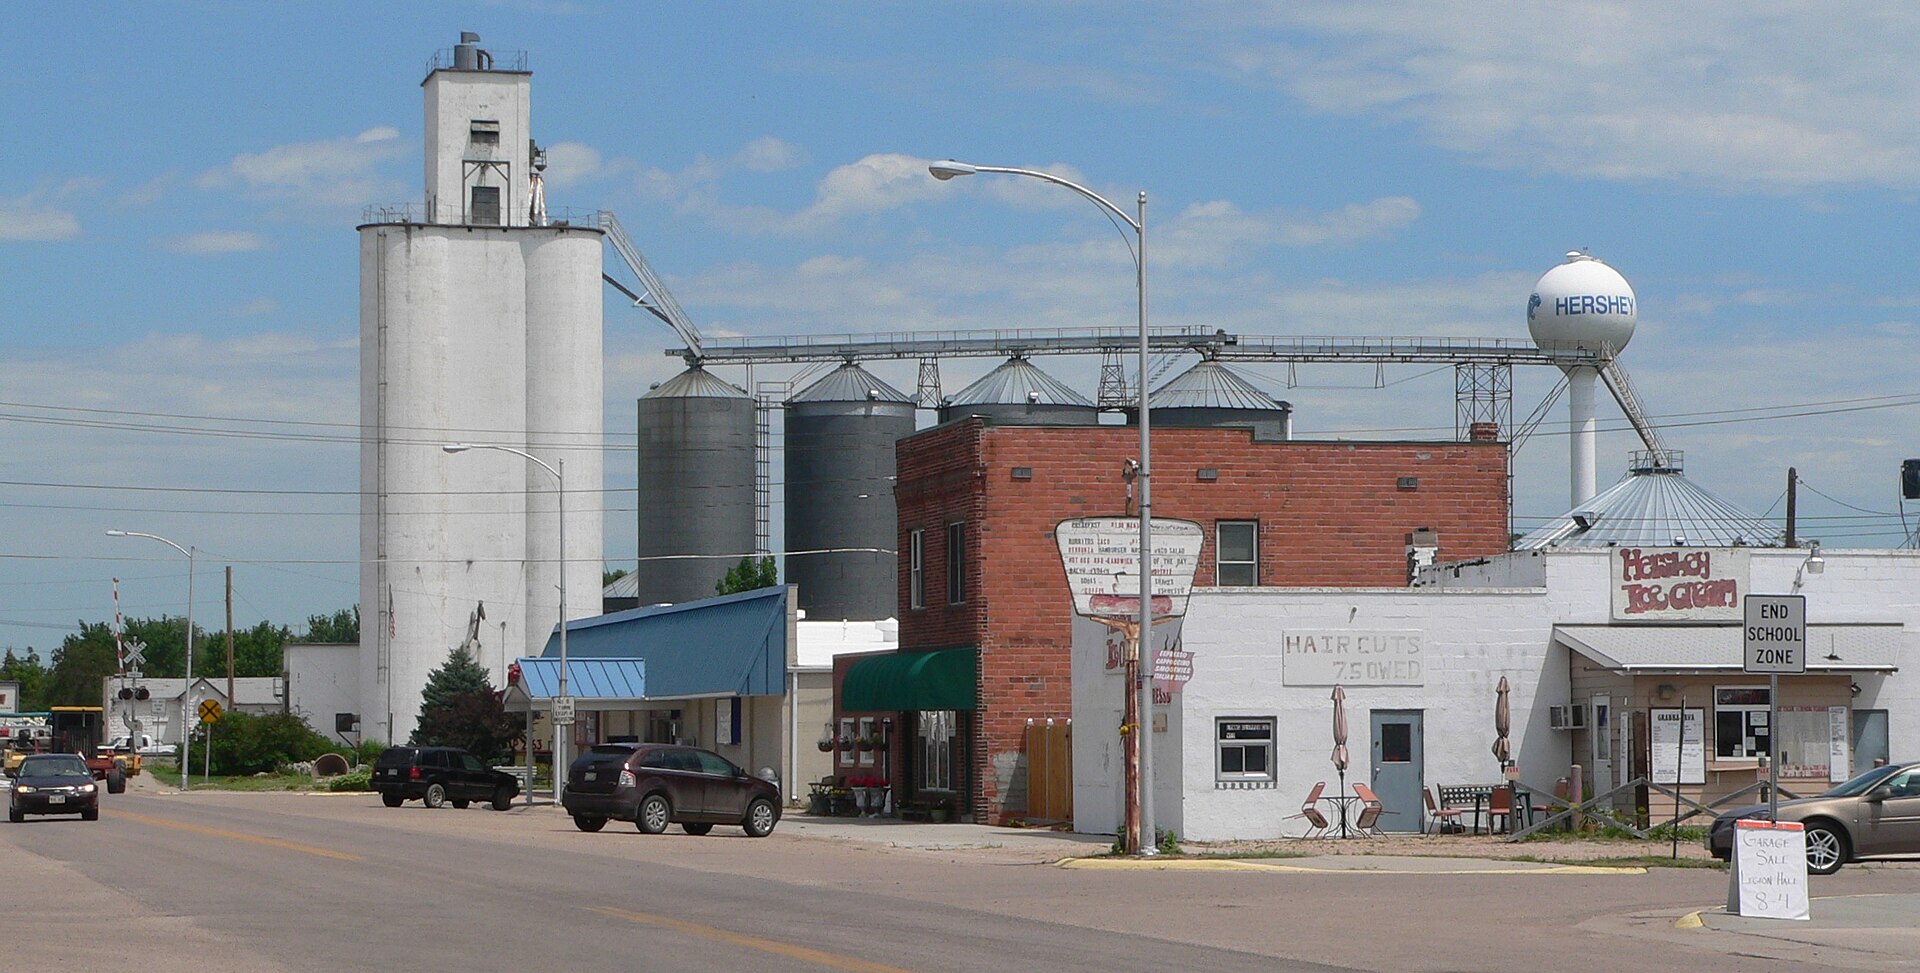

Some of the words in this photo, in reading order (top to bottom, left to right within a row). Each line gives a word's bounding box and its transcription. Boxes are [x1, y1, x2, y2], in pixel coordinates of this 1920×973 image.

[1555, 295, 1634, 316] HERSHEY
[1761, 604, 1789, 619] END
[1748, 626, 1802, 642] SCHOOL
[1756, 649, 1794, 664] ZONE
[1743, 830, 1789, 848] GARAGE
[1756, 850, 1788, 866] SALE
